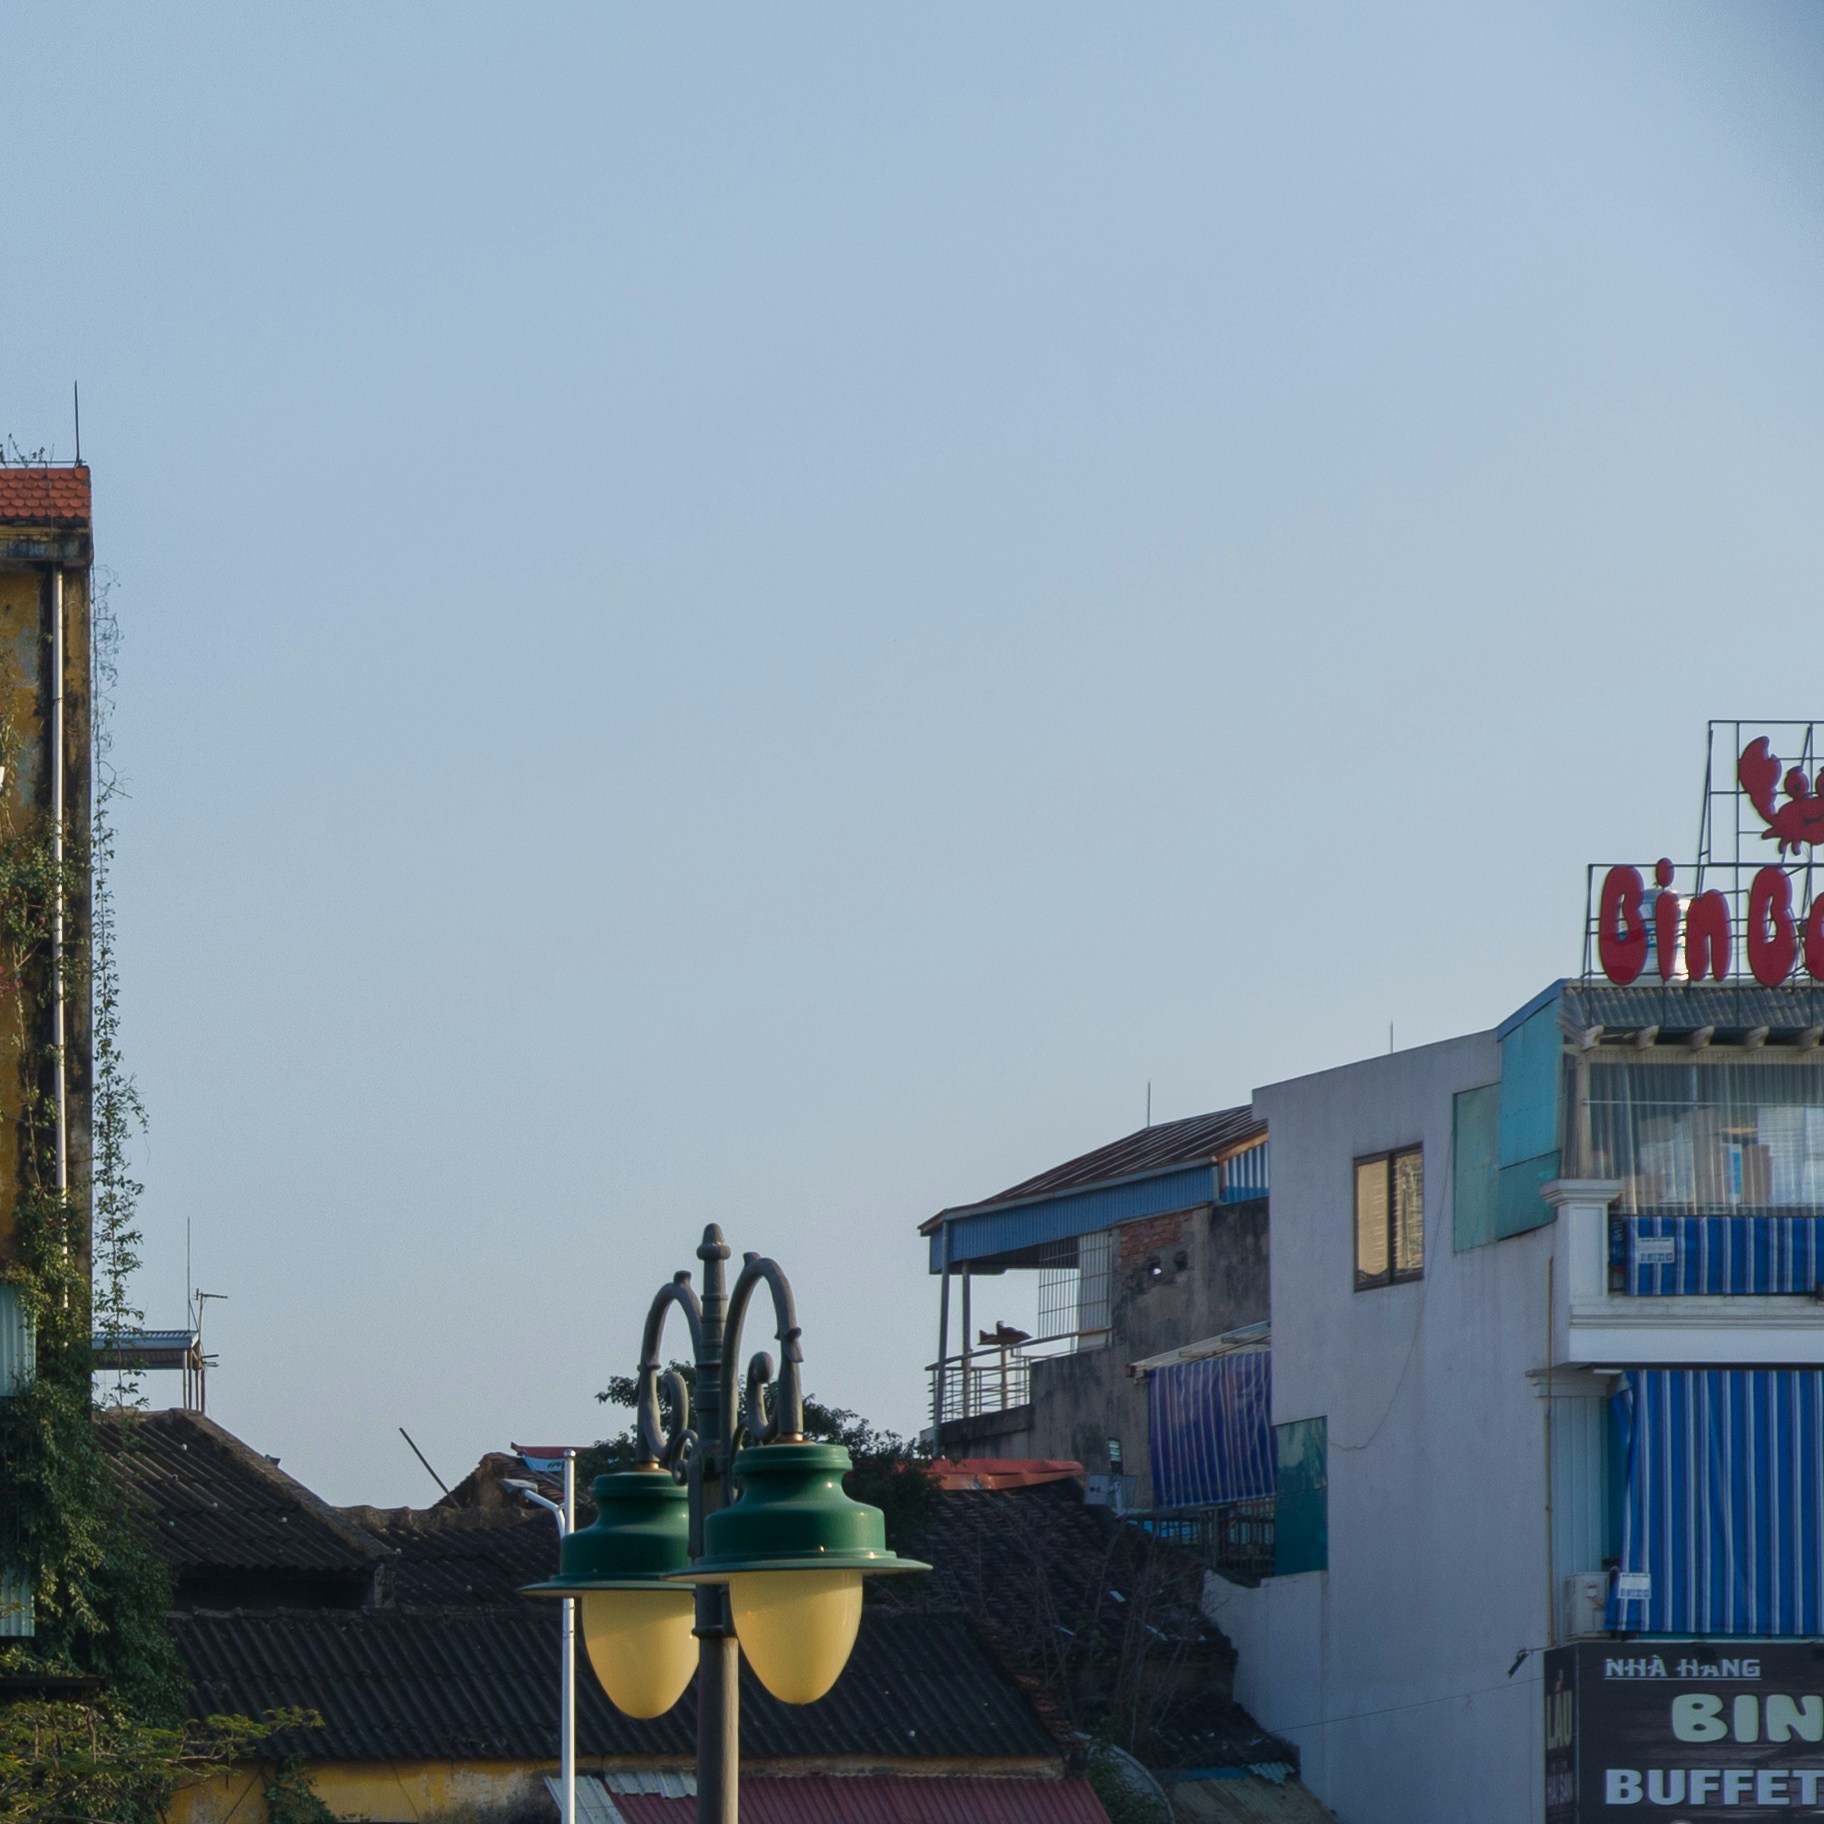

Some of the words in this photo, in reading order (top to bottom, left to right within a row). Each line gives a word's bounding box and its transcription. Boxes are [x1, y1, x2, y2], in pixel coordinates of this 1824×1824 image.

[1605, 1654, 1668, 1677] NHÀ
[1671, 1693, 1824, 1743] BIN
[1605, 1769, 1824, 1805] BUFFET
